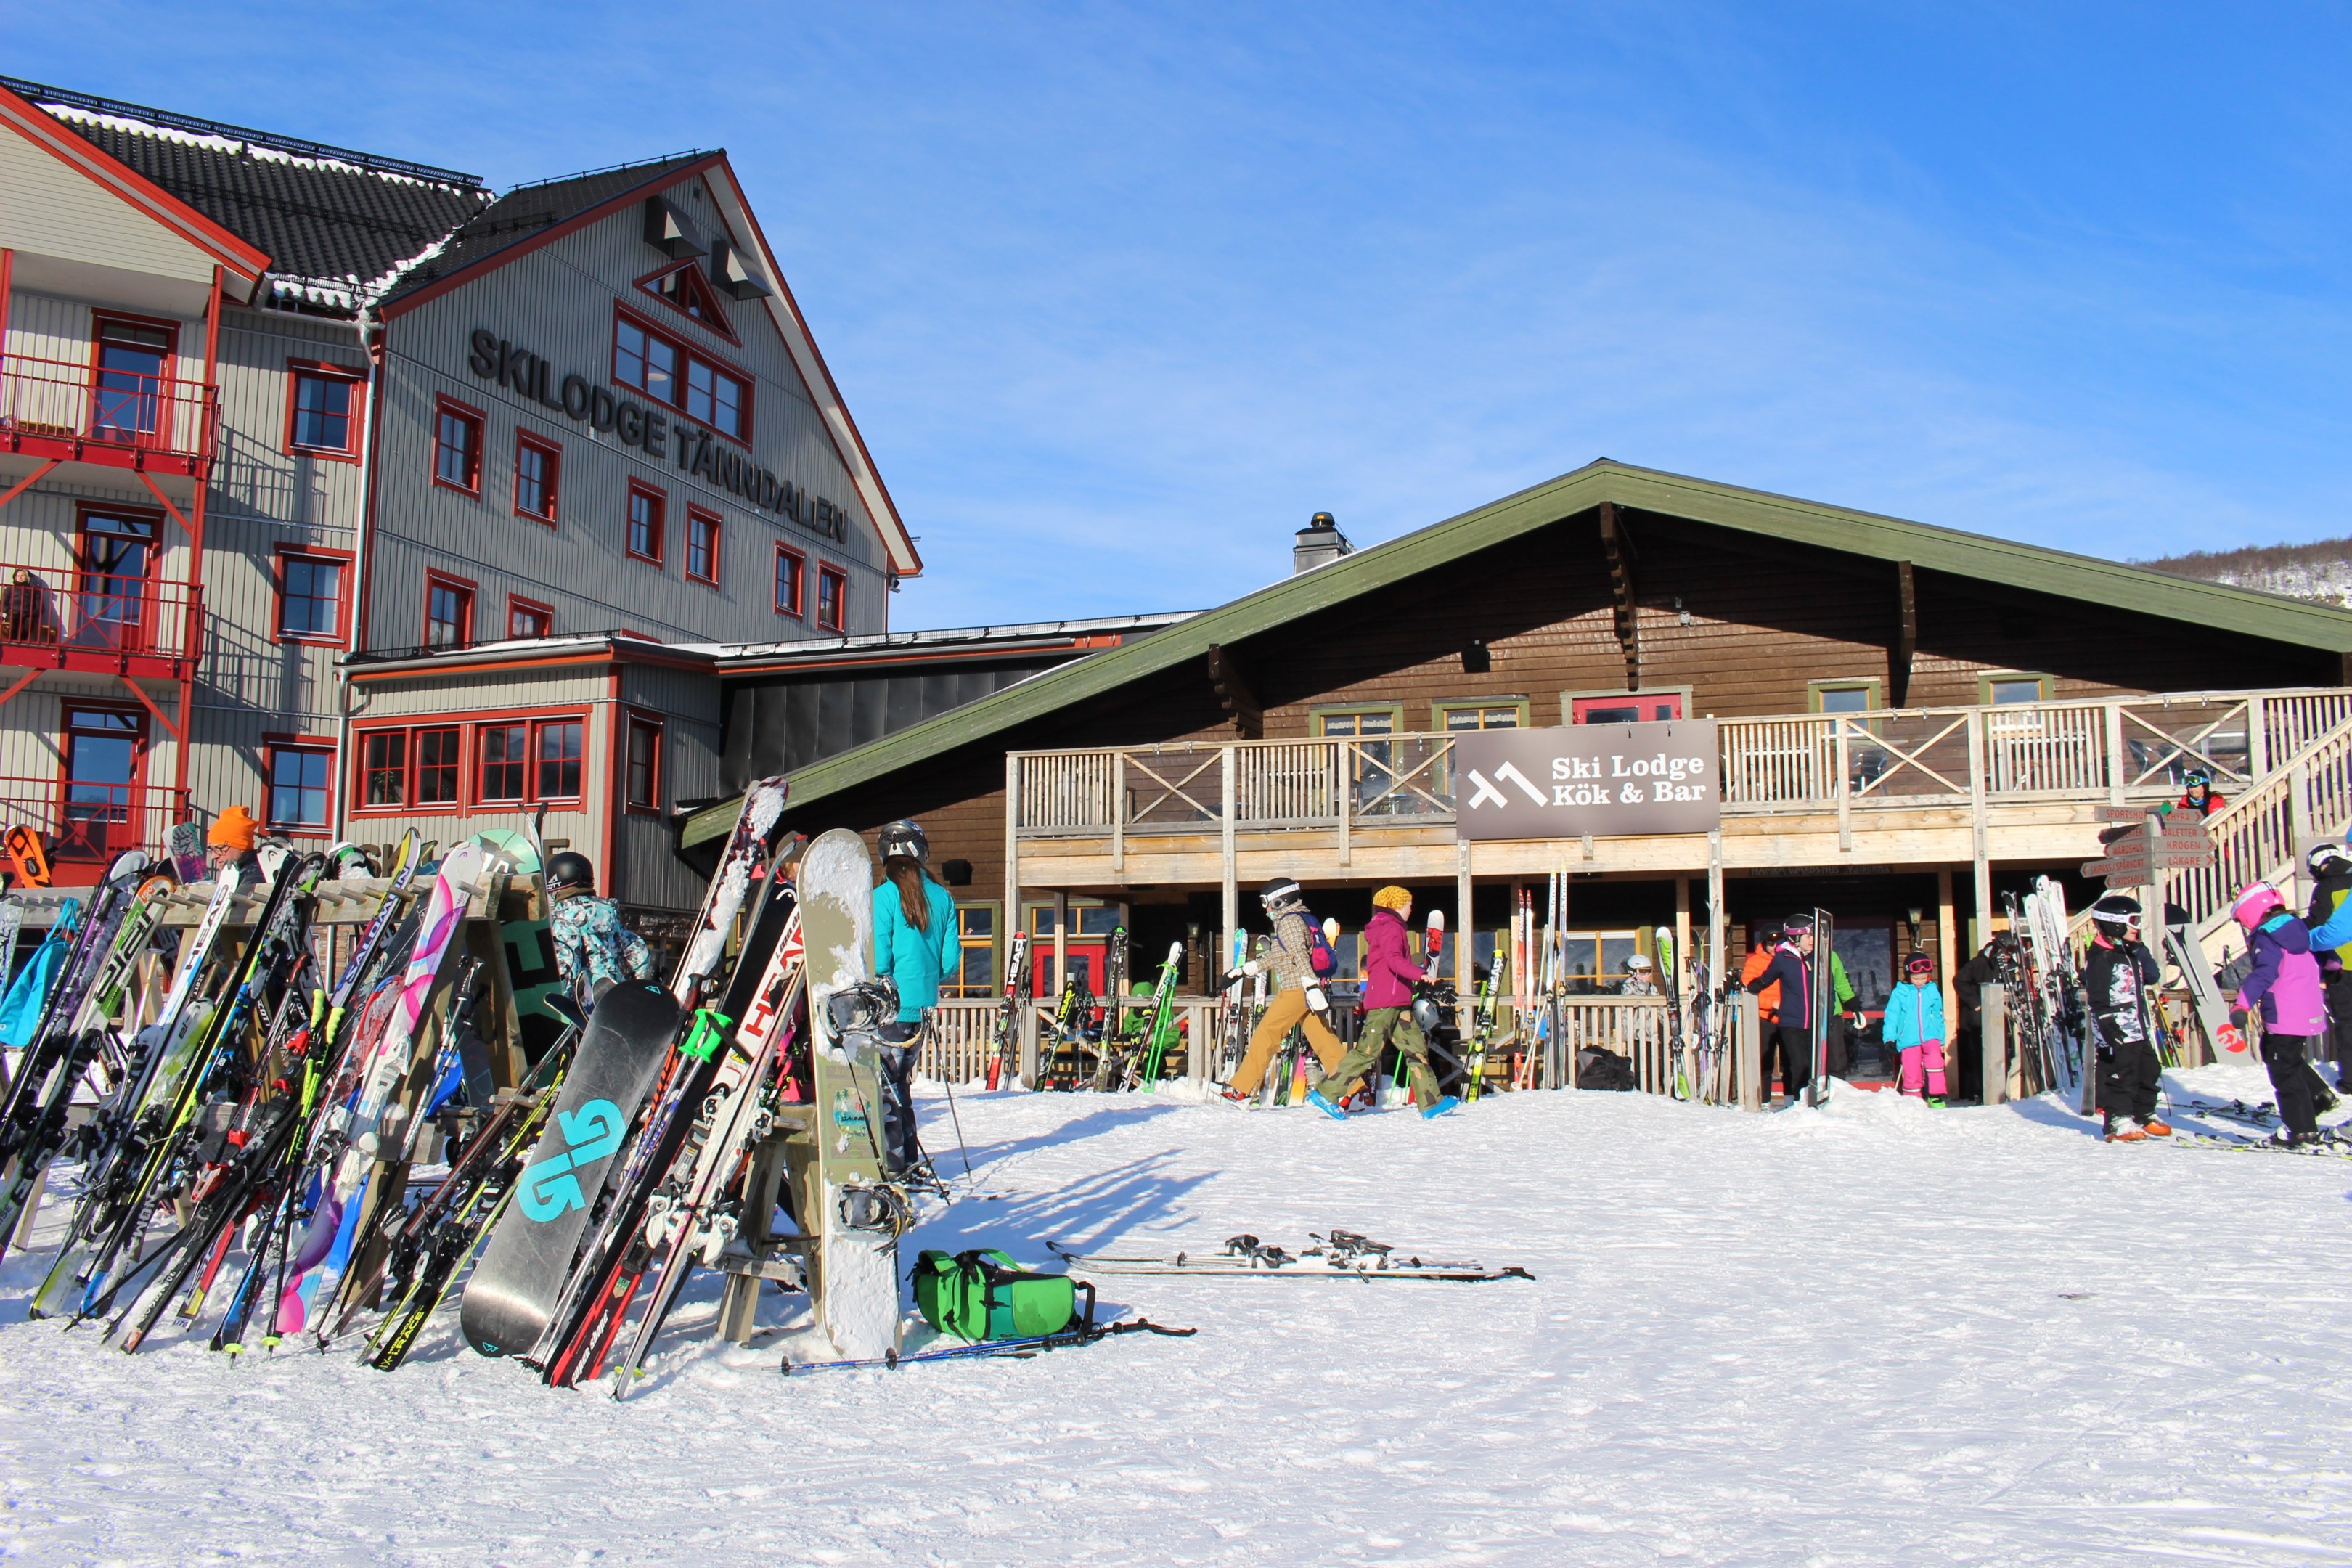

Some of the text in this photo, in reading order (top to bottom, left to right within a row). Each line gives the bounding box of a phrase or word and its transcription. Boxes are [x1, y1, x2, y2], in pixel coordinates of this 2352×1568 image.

[469, 329, 848, 544] SKILODGE TÄNNDALEN
[1551, 753, 1704, 780] Ski Lodge
[1552, 781, 1707, 807] Kök & Bar
[2106, 809, 2147, 820] SPORTSHOP
[2166, 841, 2201, 850] KROGEN
[2168, 856, 2200, 866] LÄKARE
[1008, 939, 1024, 985] HEAD
[1058, 989, 1072, 1019] HEAD
[388, 1312, 415, 1355] WORLDCUP
